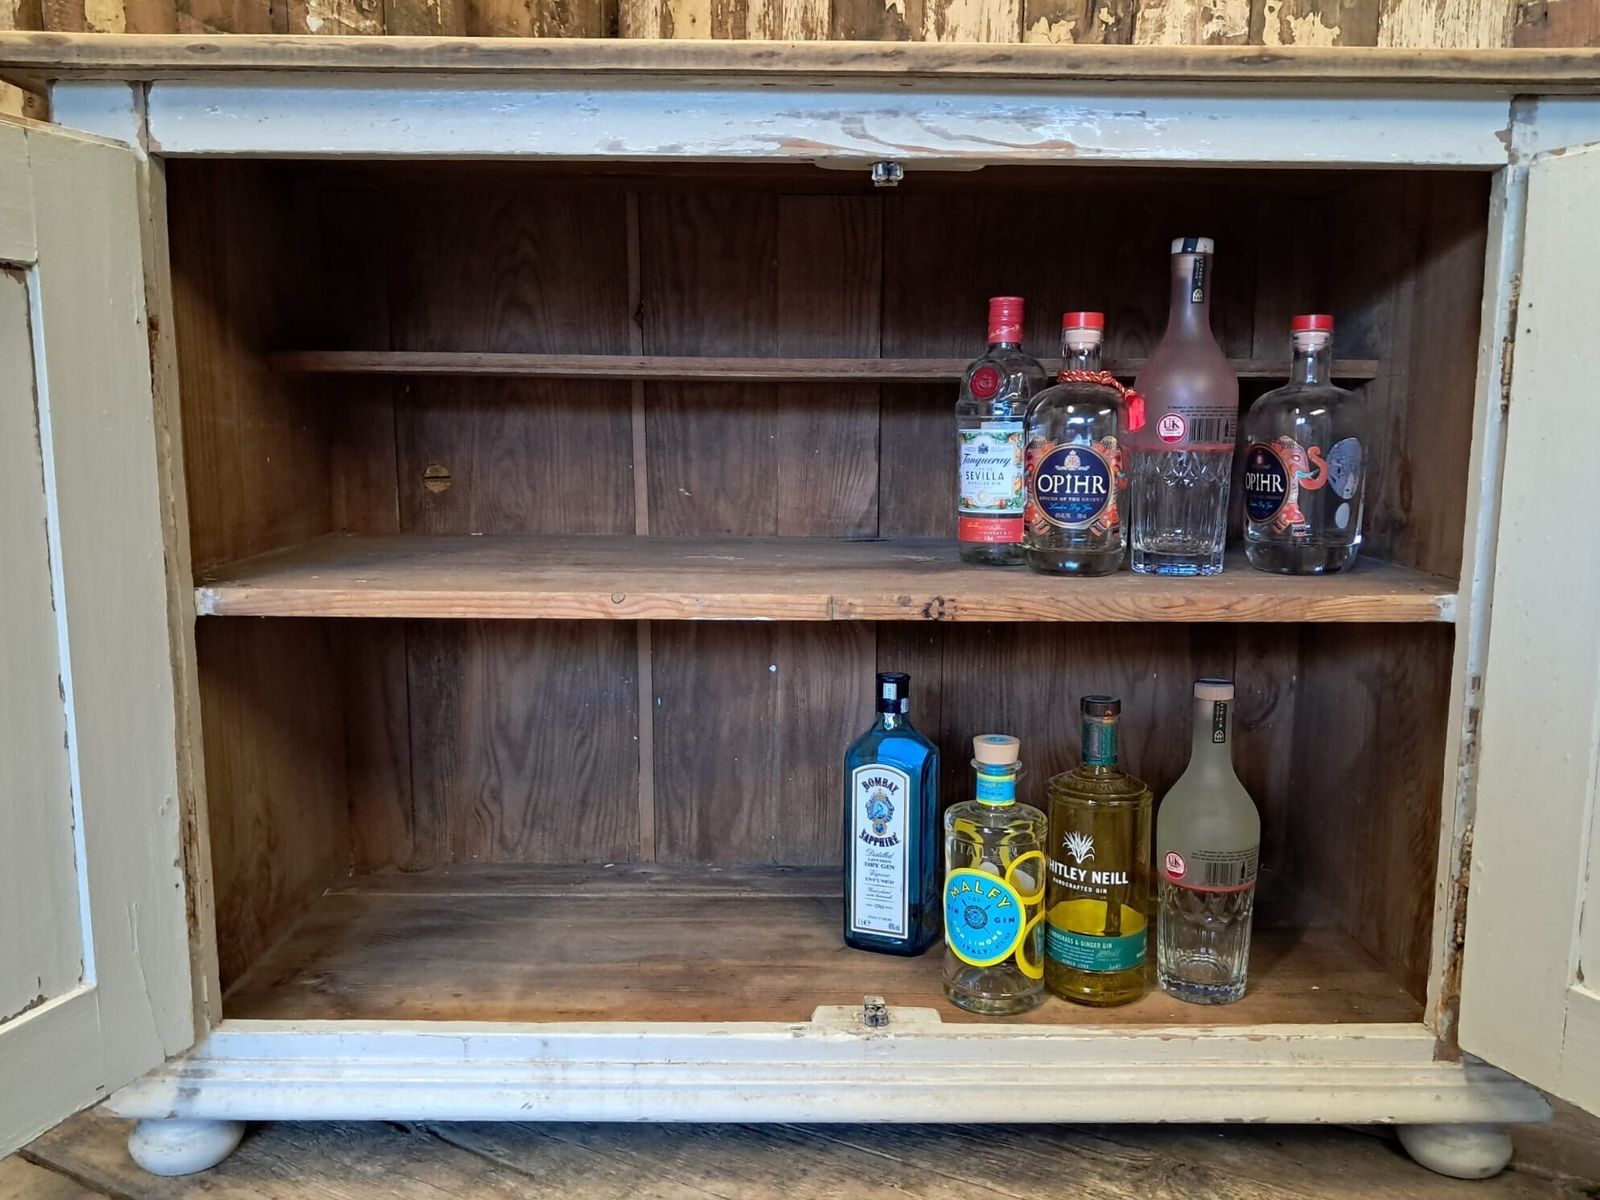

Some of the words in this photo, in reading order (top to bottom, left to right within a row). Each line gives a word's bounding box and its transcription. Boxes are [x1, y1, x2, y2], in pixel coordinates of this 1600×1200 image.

[1163, 420, 1180, 429] UK
[963, 453, 1011, 467] Tanqueray
[966, 471, 1004, 480] SEVILLA
[1245, 472, 1284, 492] OPIHR
[1038, 474, 1107, 494] OPIHR
[861, 776, 899, 796] BOMBAY
[858, 828, 902, 848] SAPPHIRE
[1052, 876, 1092, 892] HANDCRAFTED
[1092, 871, 1129, 885] NEILL
[951, 880, 1012, 908] MALFY
[994, 916, 1016, 924] GIN
[968, 930, 1002, 947] LIMONE
